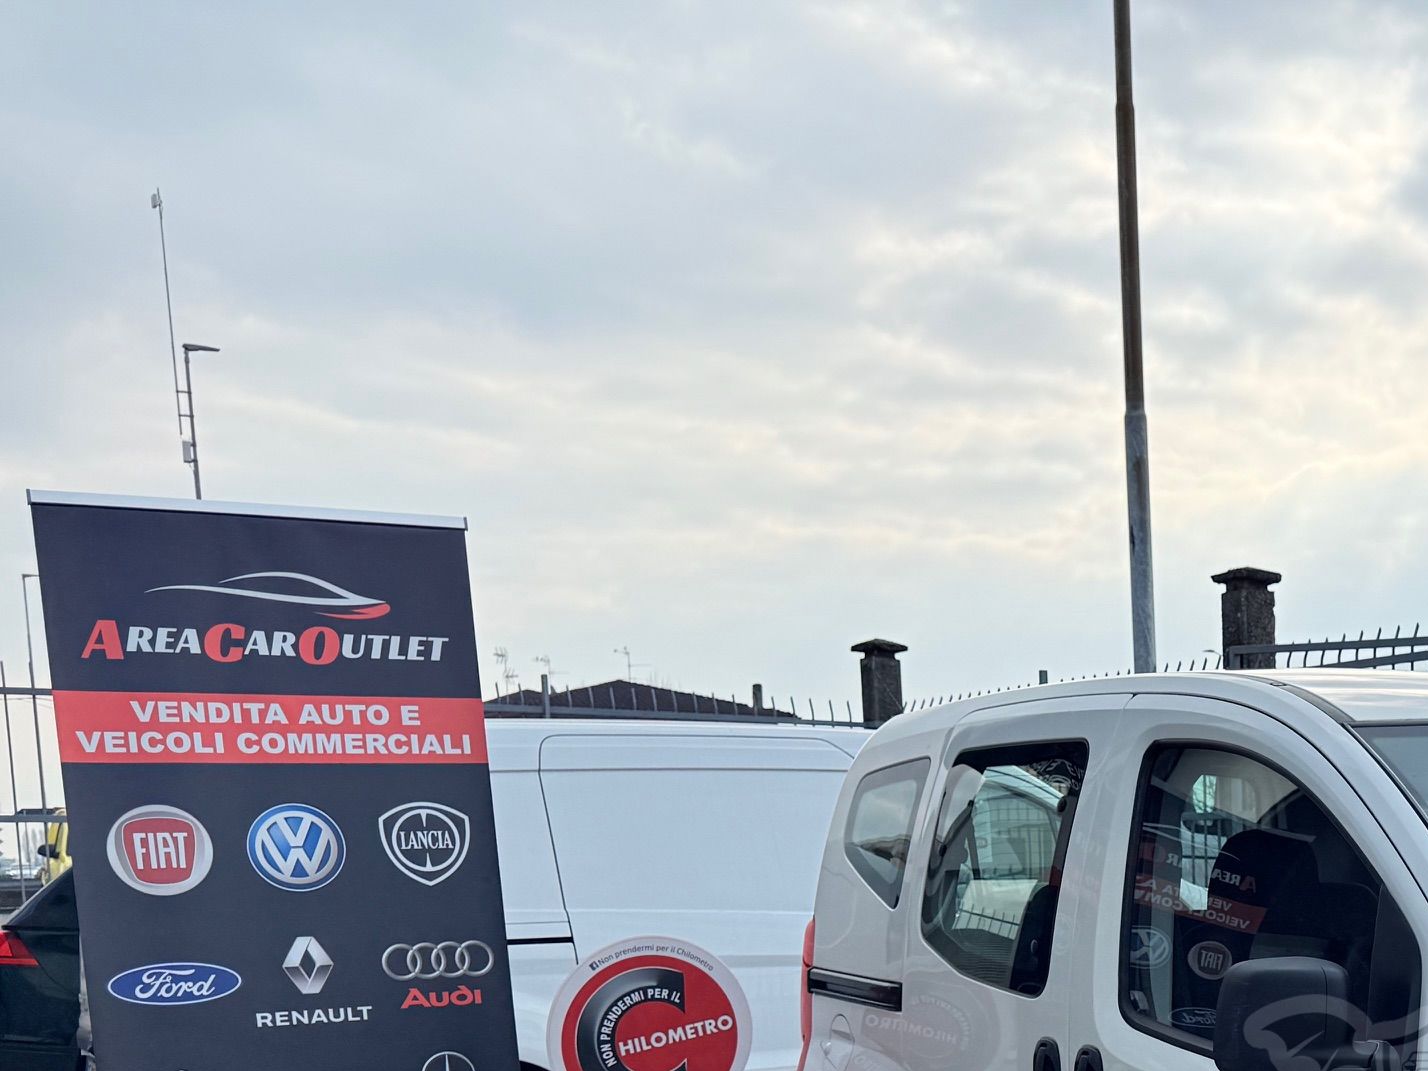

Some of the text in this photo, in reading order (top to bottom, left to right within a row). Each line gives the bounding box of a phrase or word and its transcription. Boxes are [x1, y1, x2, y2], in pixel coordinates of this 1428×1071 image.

[130, 700, 421, 726] VENDITA AUTO E
[75, 730, 472, 756] VEICOLI COMMERCIALI
[132, 831, 188, 870] FIAT
[400, 829, 454, 850] LANCIA
[597, 954, 614, 967] Non
[614, 944, 655, 959] prendermi
[655, 944, 670, 954] per
[676, 947, 714, 972] Chilometro
[134, 968, 216, 999] Ford
[255, 1005, 373, 1028] RENAULT
[600, 987, 681, 1068] NON PRENDERMI PER IL
[618, 1013, 734, 1057] HILOMETRO
